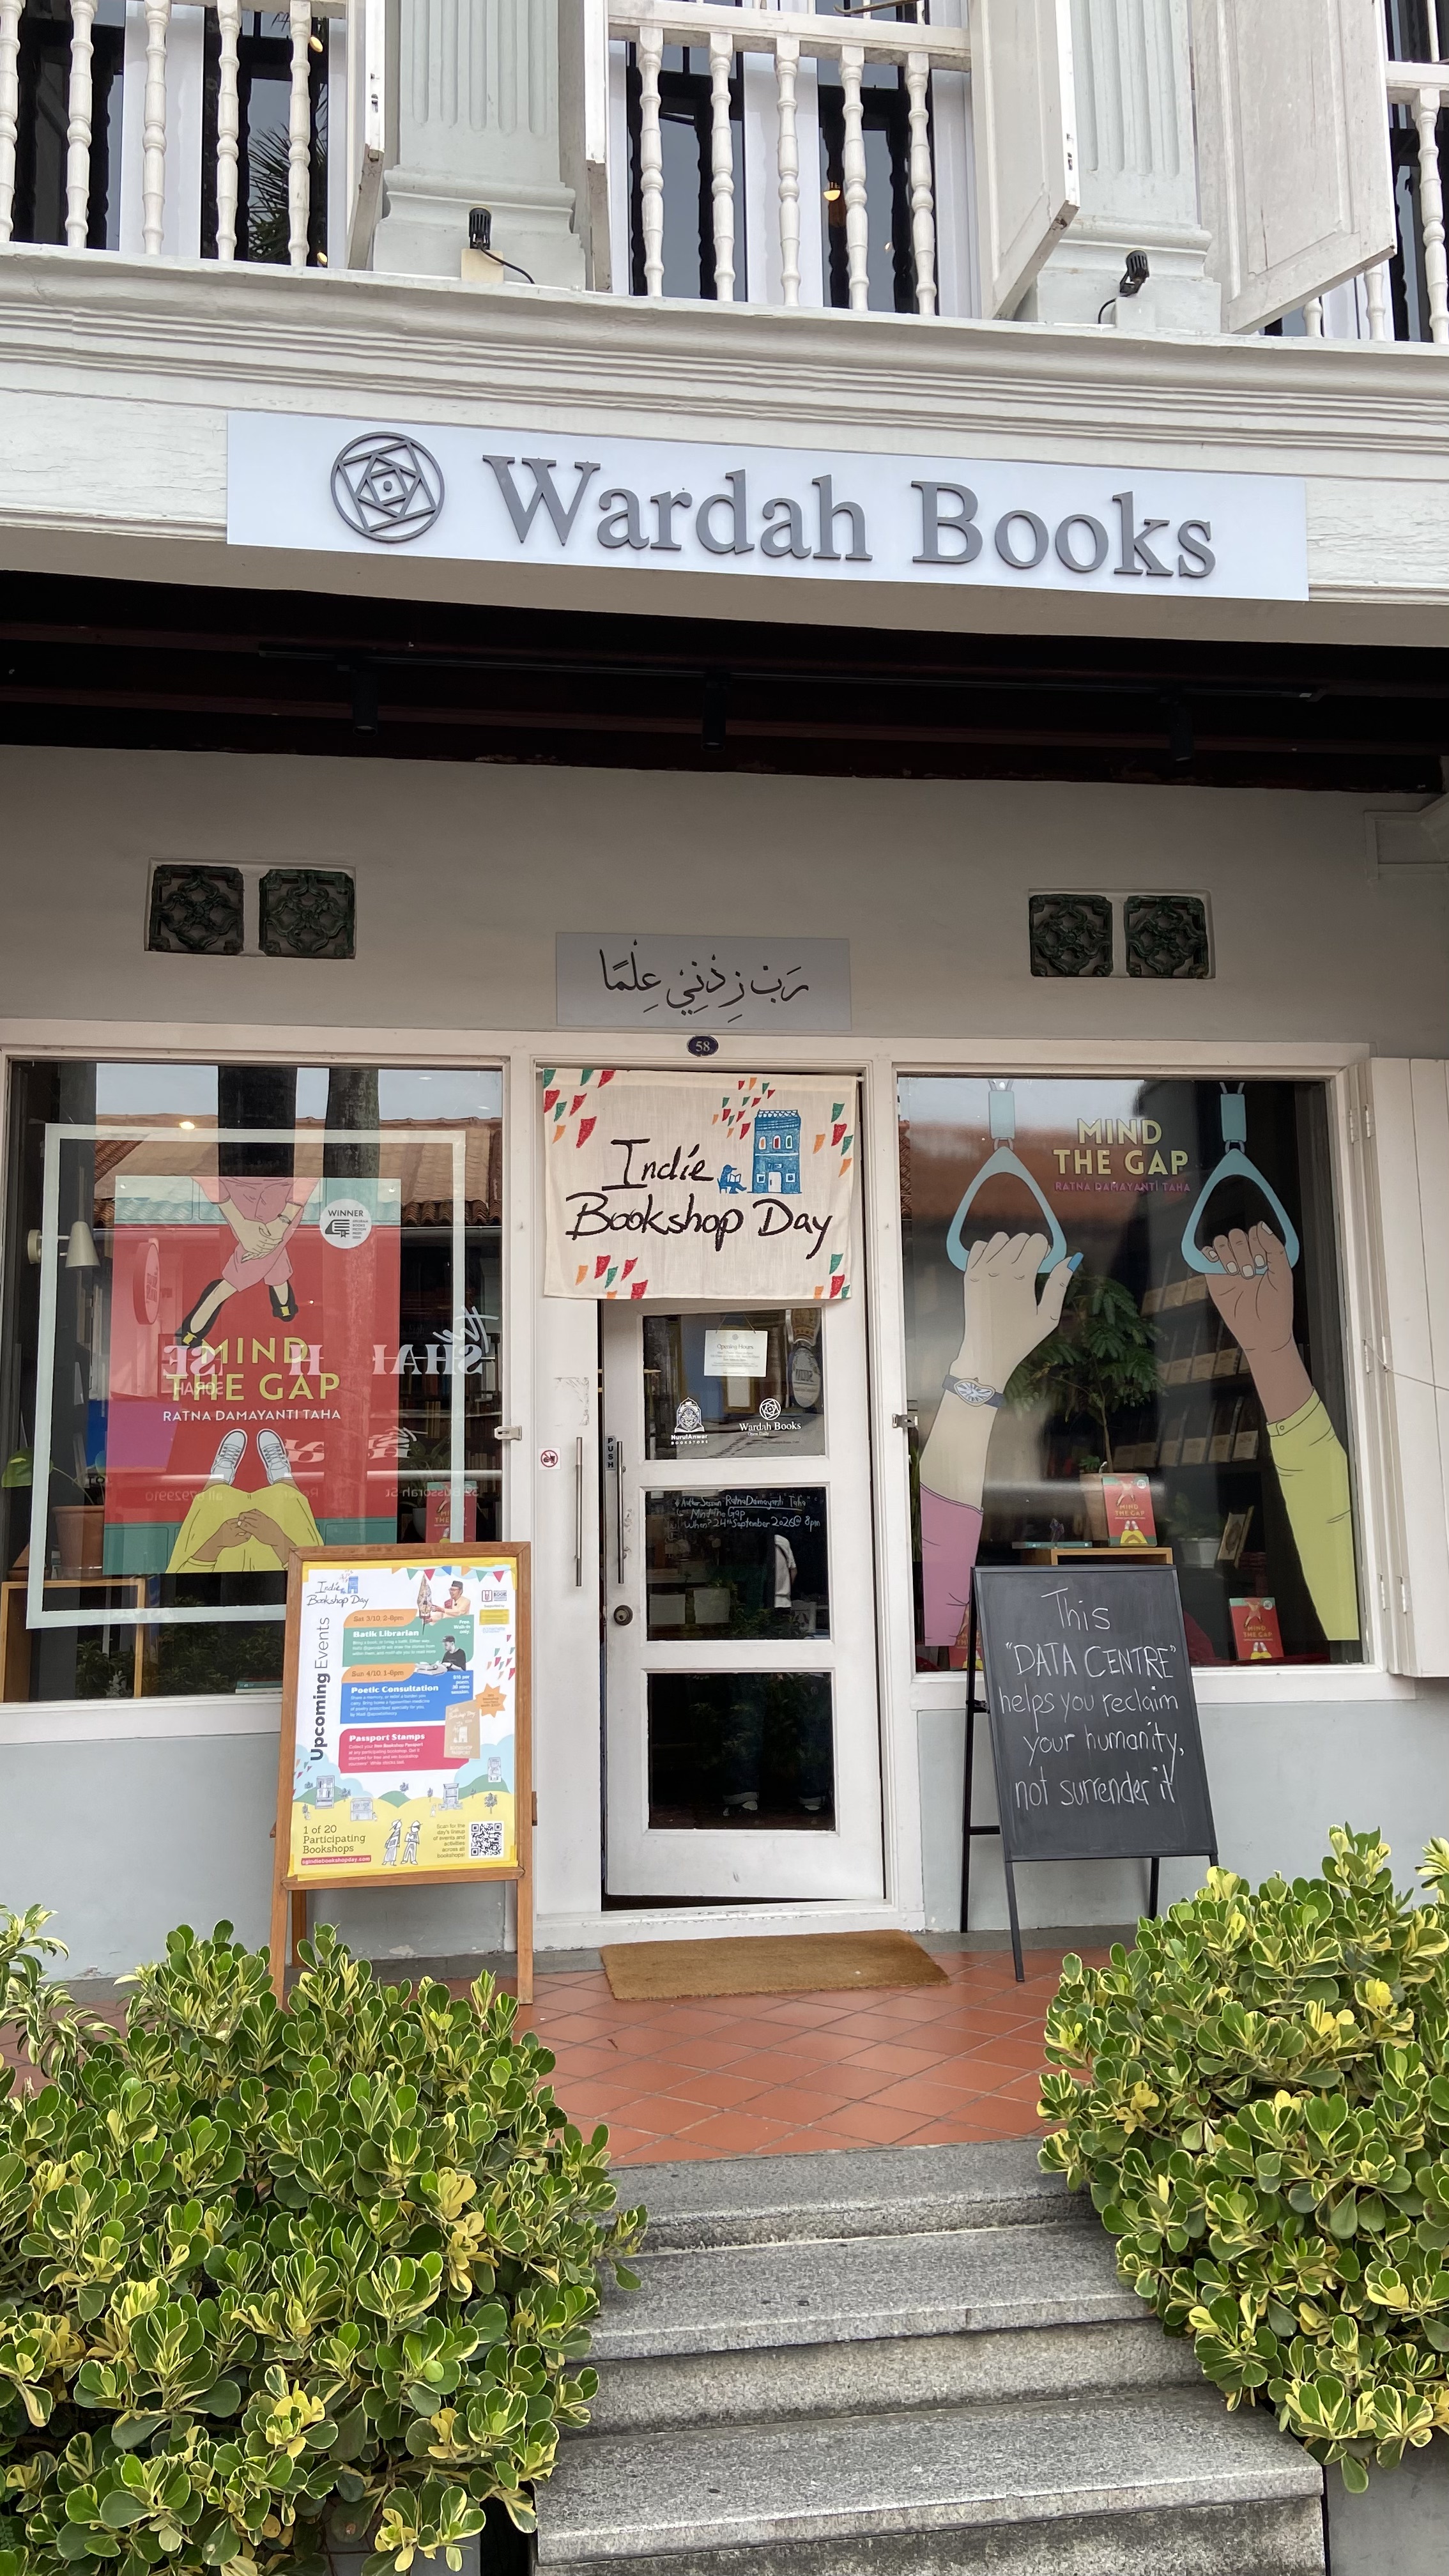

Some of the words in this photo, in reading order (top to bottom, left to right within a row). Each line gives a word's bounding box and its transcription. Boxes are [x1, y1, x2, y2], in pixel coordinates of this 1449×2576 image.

[482, 454, 873, 561] Wardah
[911, 480, 1216, 578] Books
[695, 1041, 710, 1052] 58
[1077, 1118, 1162, 1145] MIND
[602, 1138, 714, 1191] Indie
[1053, 1149, 1112, 1174] THE
[1124, 1149, 1188, 1175] GAP
[1055, 1182, 1091, 1192] RATNA
[1094, 1181, 1158, 1192] DAMAYANTI
[1162, 1182, 1191, 1192] TAHA
[565, 1192, 744, 1252] Bookshop
[752, 1198, 833, 1260] Day
[201, 1337, 308, 1364] MIND
[166, 1373, 245, 1401] THE
[259, 1372, 341, 1401] GAP
[163, 1411, 211, 1422] RATNA
[215, 1409, 298, 1421] DAMAYANTI
[302, 1409, 341, 1420] TAHA
[739, 1422, 772, 1431] Wardah
[774, 1421, 802, 1430] Books
[684, 1519, 712, 1529] When?
[804, 1515, 821, 1532] 8pm
[728, 1508, 746, 1521] Gap
[315, 1581, 341, 1593] Indie
[307, 1595, 349, 1608] Bookshop
[350, 1595, 369, 1609] Day
[1041, 1588, 1110, 1630] This
[315, 1617, 330, 1669] Events
[382, 1685, 439, 1693] Consultation
[310, 1673, 330, 1761] Upcoming
[999, 1683, 1055, 1733] helps
[1060, 1692, 1094, 1723] you
[1103, 1685, 1178, 1717] reclaim
[1023, 1733, 1075, 1767] your
[1084, 1721, 1184, 1782] humanity,
[1015, 1766, 1048, 1810] not
[1060, 1770, 1151, 1806] surrender
[1151, 1764, 1175, 1804] it
[303, 1834, 366, 1844] Participating
[312, 1825, 321, 1834] of
[325, 1825, 337, 1834] 20
[303, 1844, 354, 1854] Bookshops
